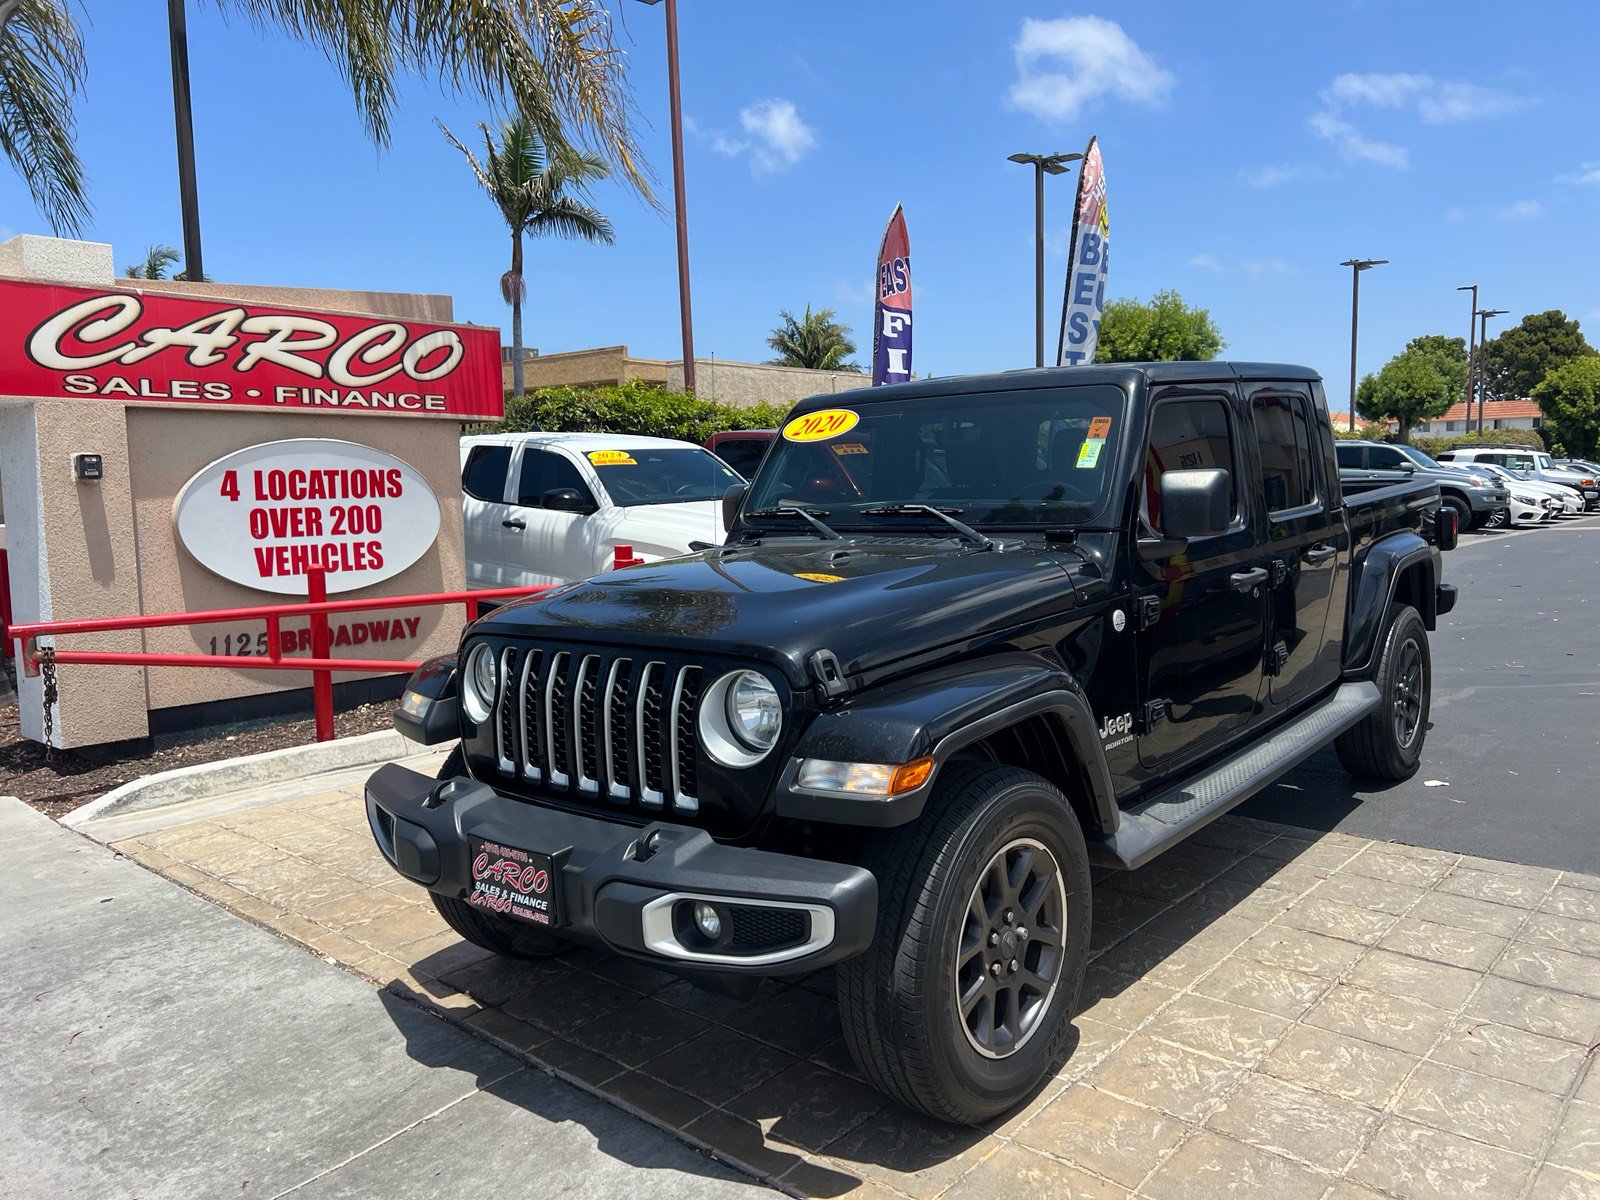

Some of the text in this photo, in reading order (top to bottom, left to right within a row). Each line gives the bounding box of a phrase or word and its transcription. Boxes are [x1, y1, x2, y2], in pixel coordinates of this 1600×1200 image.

[24, 294, 465, 388] CARCO
[882, 308, 911, 386] FI
[63, 374, 448, 411] SALES FINANCE
[791, 413, 848, 437] 2020
[220, 469, 403, 502] 4 LOCATIONS
[250, 504, 383, 540] OVER 200
[254, 540, 384, 578] VEHICLES
[210, 616, 421, 656] 1125 BRADWAY
[1098, 712, 1133, 739] Jeep
[1105, 734, 1134, 751] ADIATOR
[472, 853, 549, 894] CARCO
[475, 881, 547, 910] SALES & FINANCE
